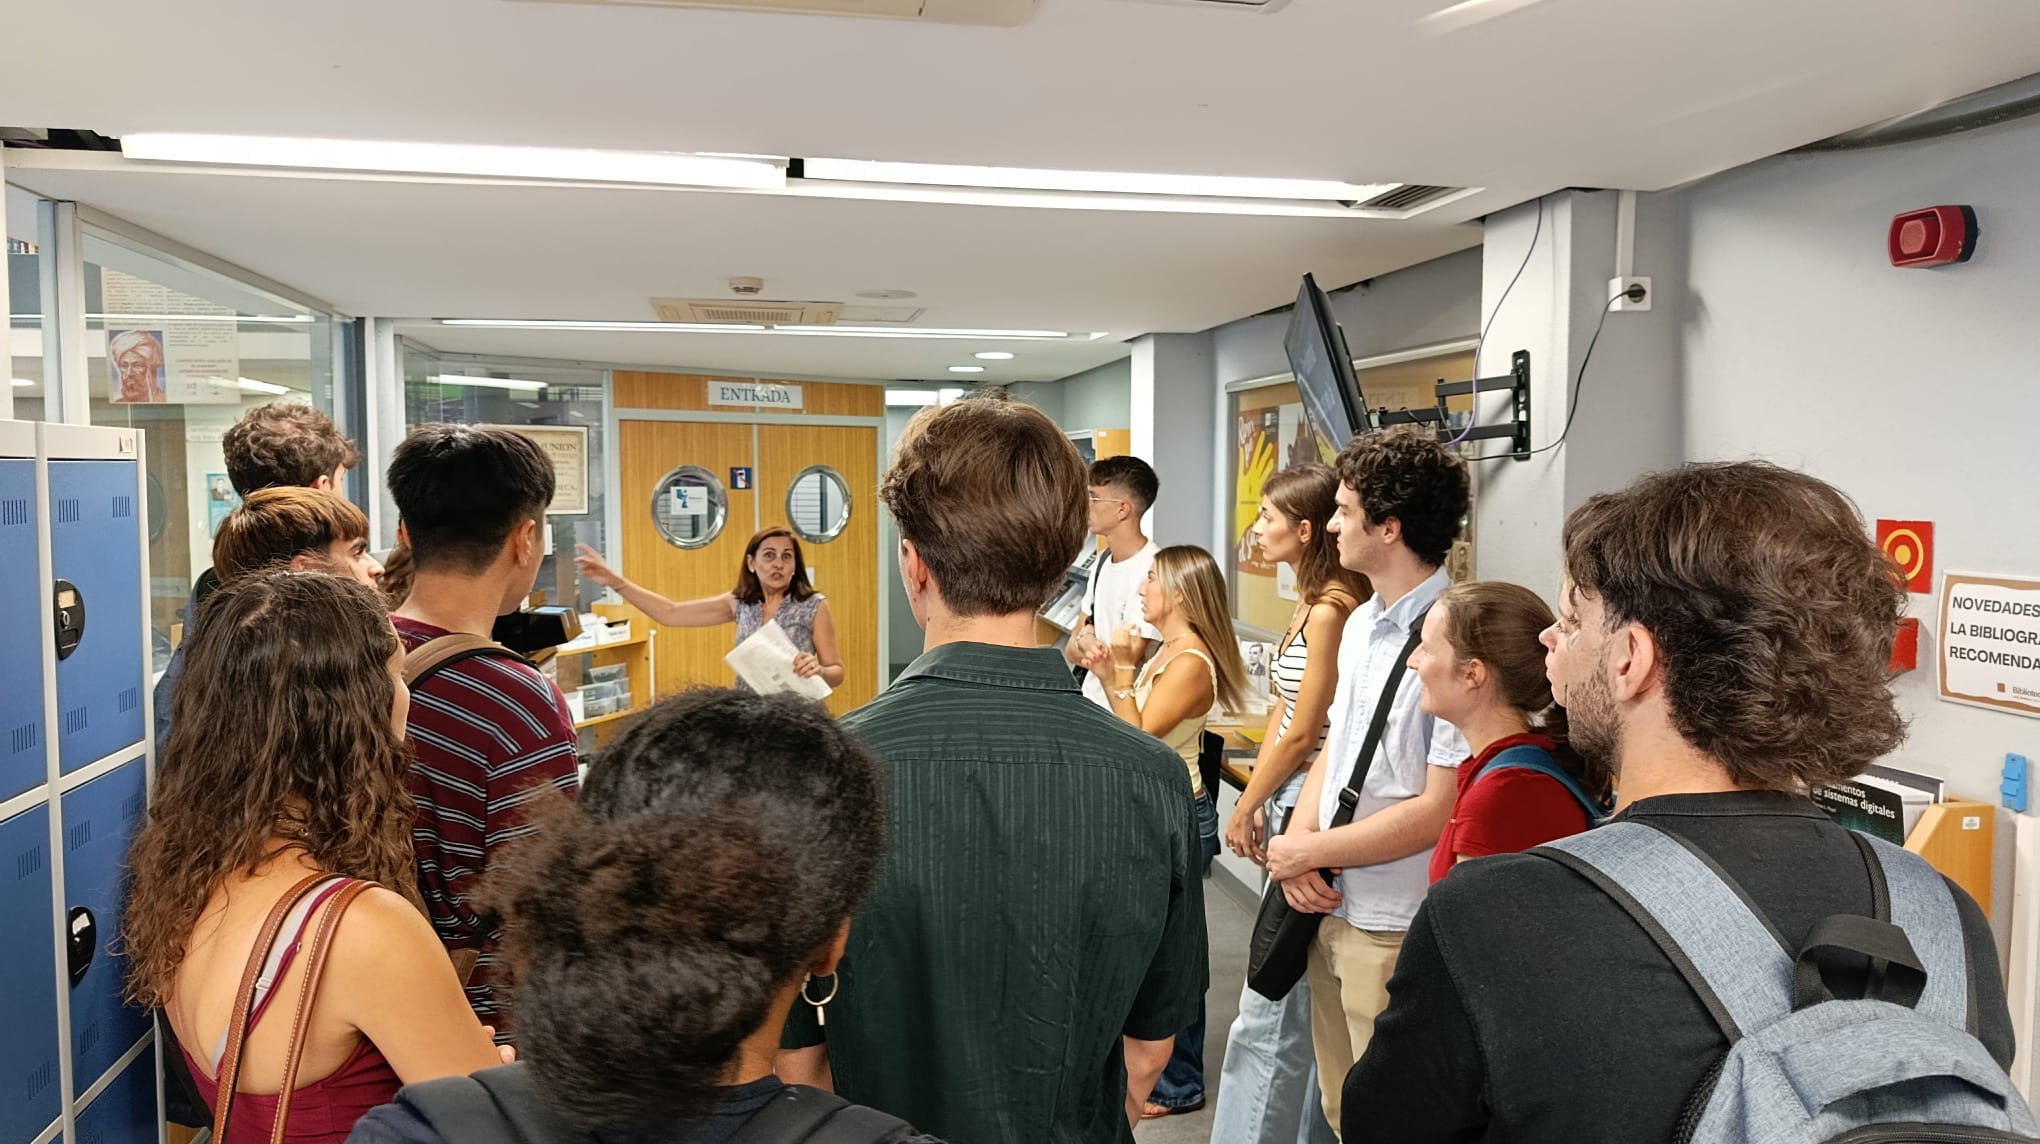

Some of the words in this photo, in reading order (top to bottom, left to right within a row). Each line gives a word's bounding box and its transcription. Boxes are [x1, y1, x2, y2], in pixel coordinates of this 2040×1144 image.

[720, 387, 791, 403] ENTRADA
[1952, 596, 2040, 617] NOVEDADES
[1950, 622, 1967, 636] LA
[1970, 624, 2040, 646] BIBLIOGR
[1823, 790, 1859, 808] sistemas
[1860, 801, 1895, 819] digitales
